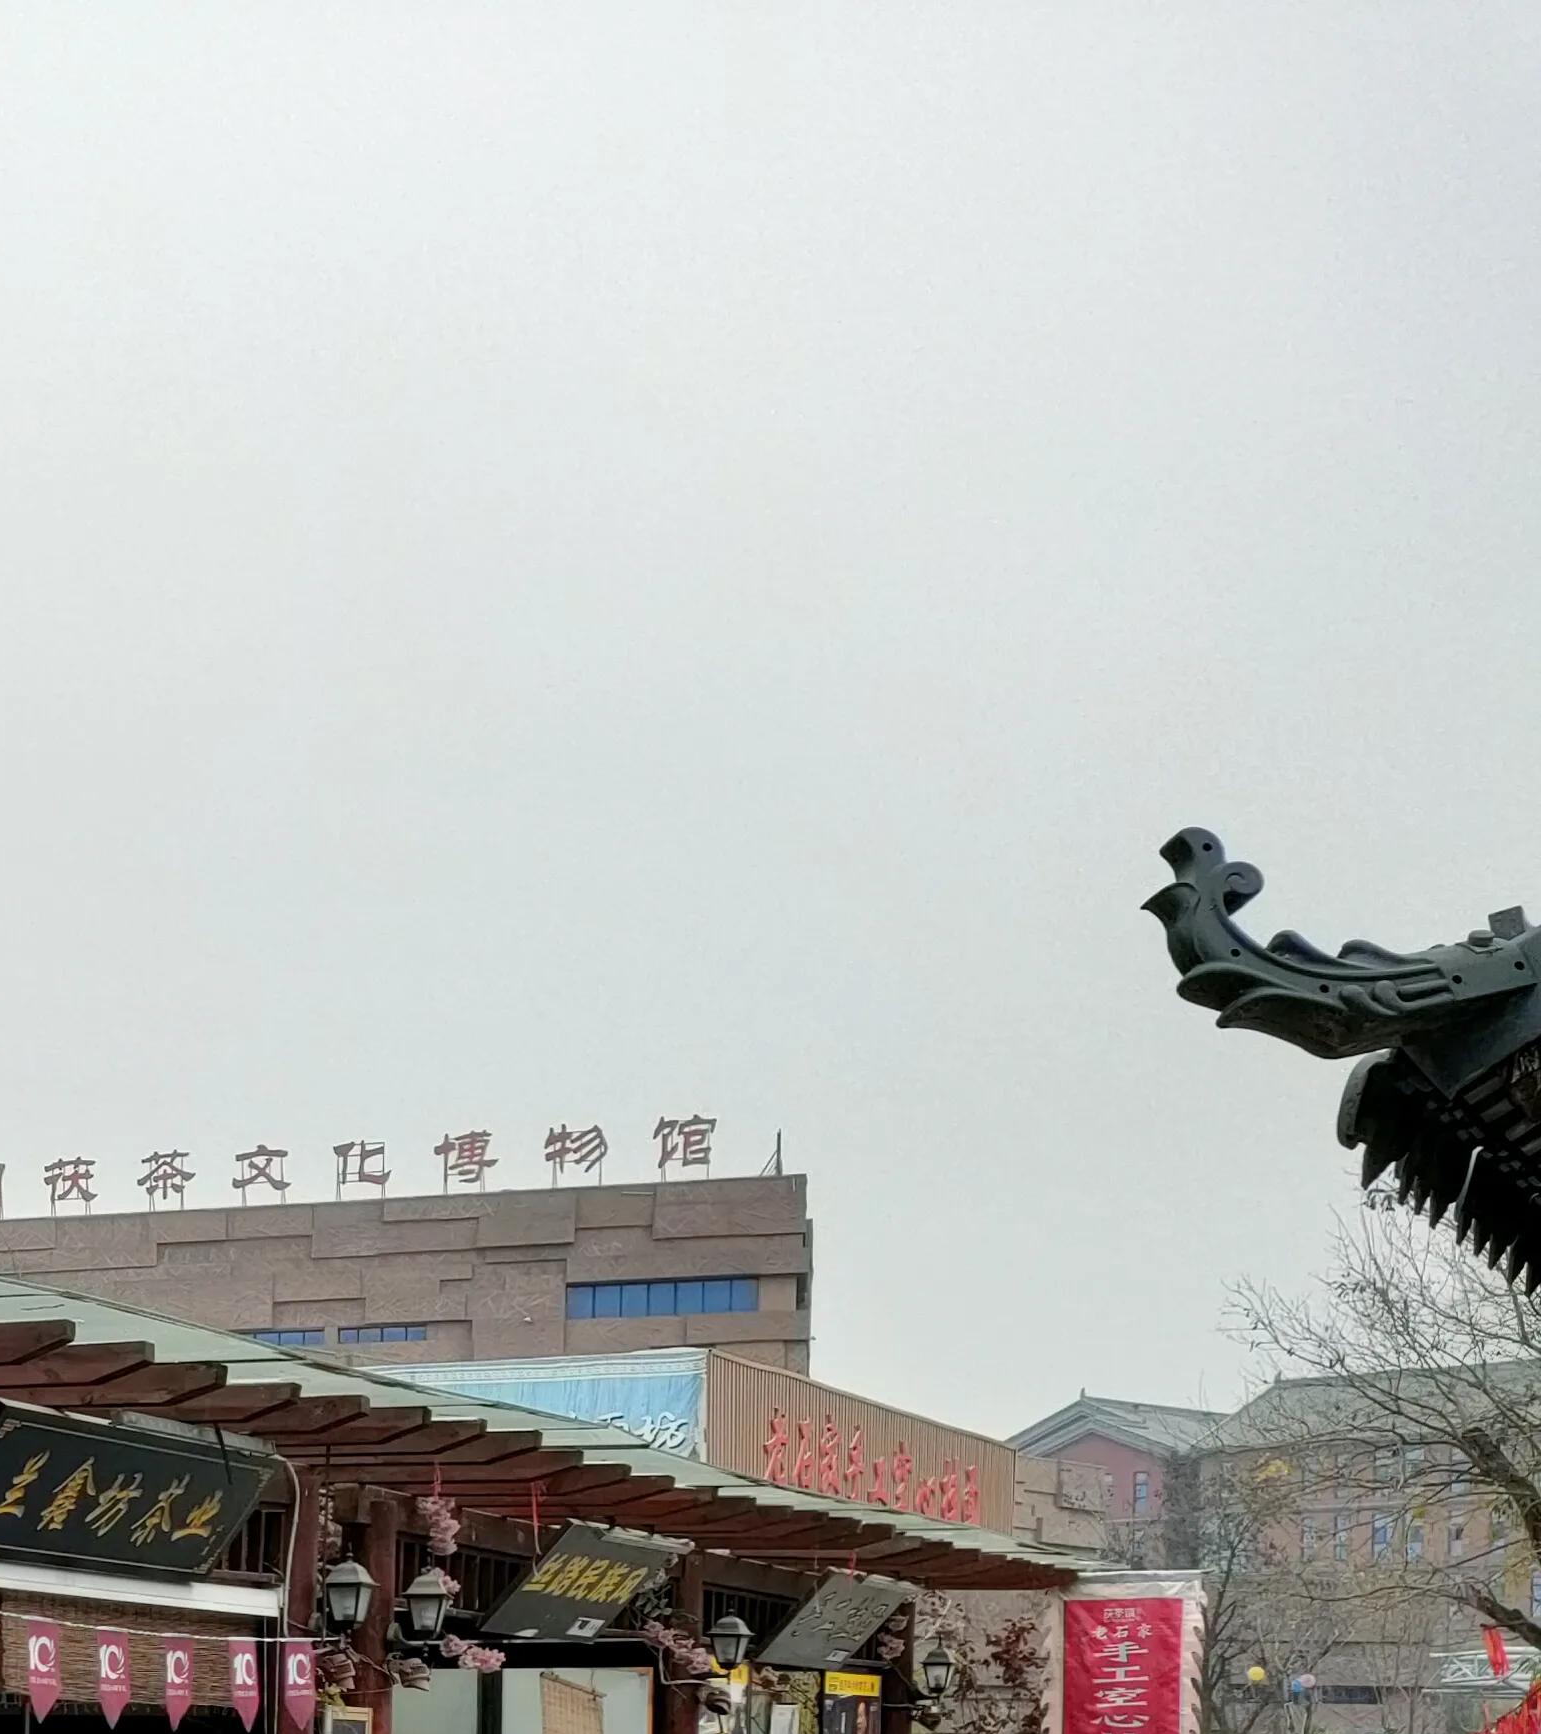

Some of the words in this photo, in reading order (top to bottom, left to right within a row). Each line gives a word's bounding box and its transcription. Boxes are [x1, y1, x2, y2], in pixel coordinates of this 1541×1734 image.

[521, 1552, 649, 1605] 丝路民族风
[1091, 1623, 1154, 1640] 老石家
